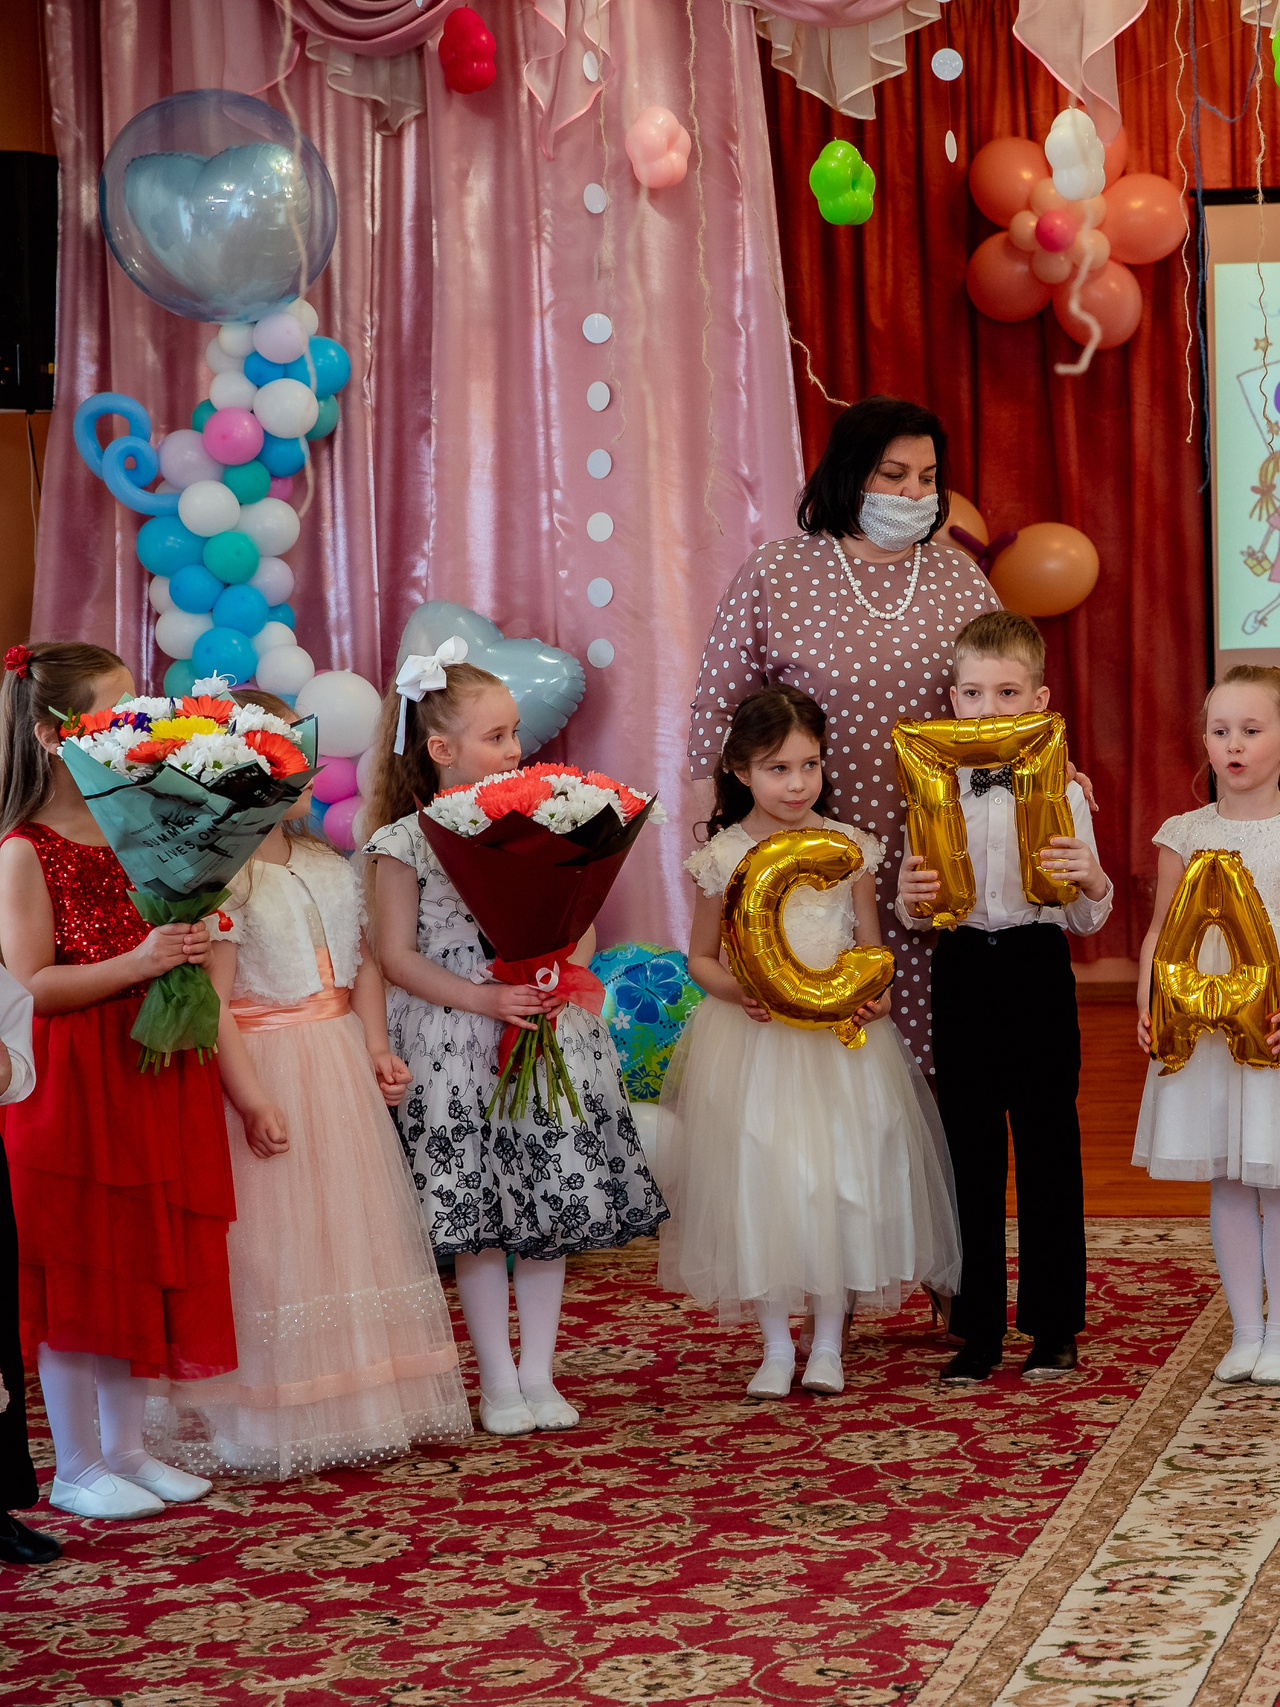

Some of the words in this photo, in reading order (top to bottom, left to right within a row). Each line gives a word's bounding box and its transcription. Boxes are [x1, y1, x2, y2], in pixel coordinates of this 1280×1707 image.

[142, 814, 199, 848] SUMMER
[157, 839, 196, 863] LIVES
[198, 824, 220, 842] ON
